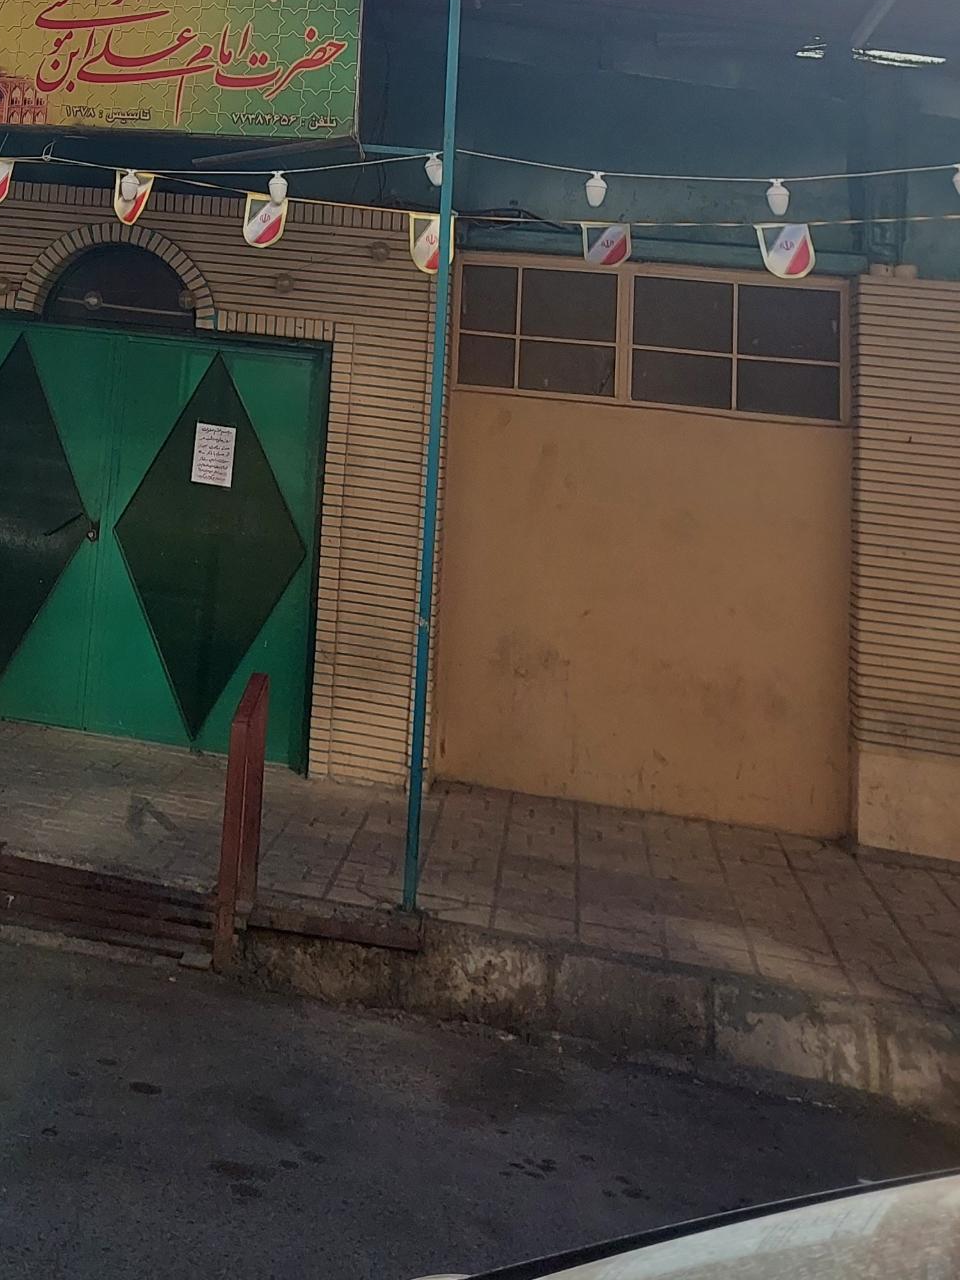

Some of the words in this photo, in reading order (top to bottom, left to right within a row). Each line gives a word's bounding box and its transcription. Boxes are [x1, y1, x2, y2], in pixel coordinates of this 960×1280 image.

[34, 27, 96, 93] ابن
[175, 22, 253, 124] امام
[213, 26, 348, 100] حضرت
[65, 104, 96, 118] ۱۳۷۸
[231, 112, 298, 126] ۷۷۳۸۴۶۵۶
[307, 115, 338, 131] تلفن
